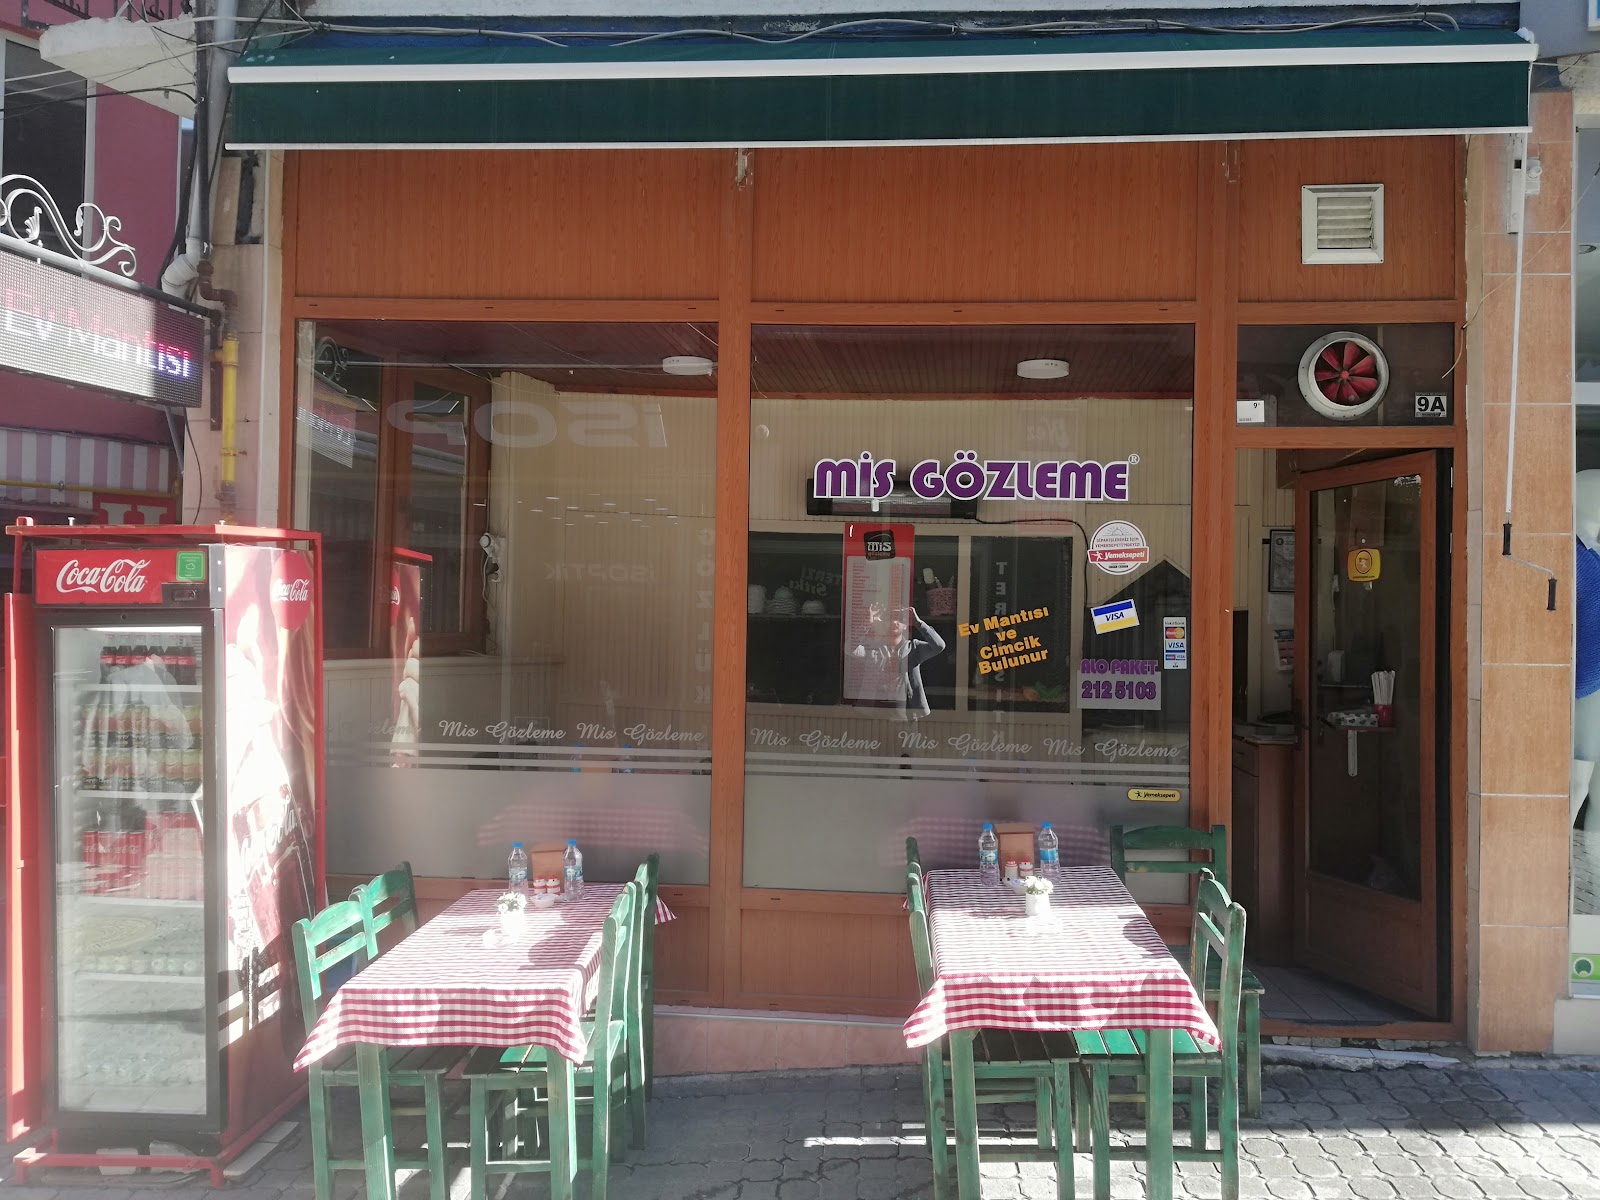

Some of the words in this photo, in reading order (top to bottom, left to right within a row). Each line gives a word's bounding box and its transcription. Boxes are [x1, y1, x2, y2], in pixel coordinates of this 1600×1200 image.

[1417, 396, 1446, 412] 9A
[909, 450, 1129, 501] GÖZLEME
[56, 558, 152, 595] Coca-Cola
[271, 578, 311, 603] Coca-Cola
[958, 623, 980, 637] Ev
[983, 607, 1050, 631] Mantısı
[1105, 611, 1125, 622] VISA
[980, 635, 1042, 660] Cimcik
[996, 629, 1017, 642] ve
[978, 649, 1049, 675] Bulunur
[1080, 658, 1109, 675] ALO
[1111, 658, 1158, 675] PAKET
[1081, 680, 1113, 699] 212
[1114, 681, 1158, 700] 5103
[438, 719, 479, 738] Mis
[485, 721, 567, 744] Gözleme
[576, 722, 617, 741] Mis
[623, 723, 706, 746] Gözleme
[750, 727, 791, 747] Mis
[799, 729, 882, 754] Gözleme
[897, 730, 940, 750] Mis
[947, 733, 1033, 757] Gözleme
[1043, 737, 1086, 756] Mis
[1094, 738, 1182, 763] Gözleme
